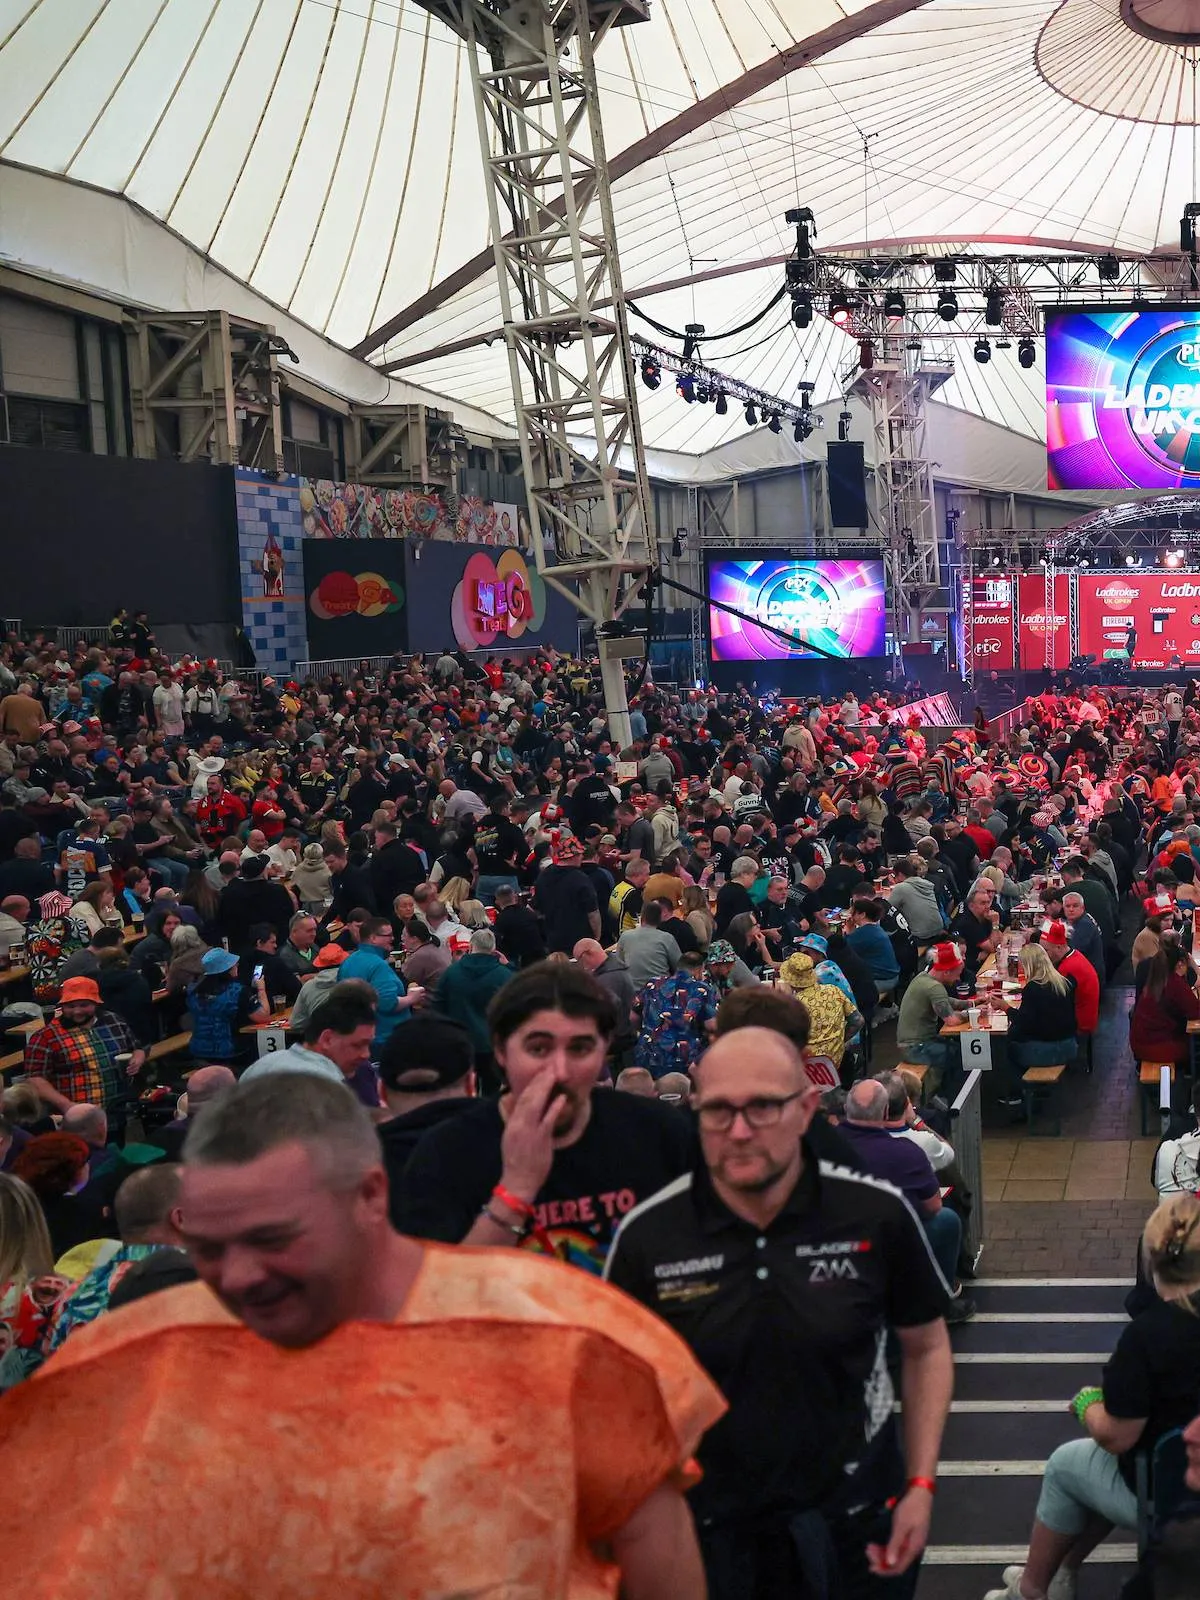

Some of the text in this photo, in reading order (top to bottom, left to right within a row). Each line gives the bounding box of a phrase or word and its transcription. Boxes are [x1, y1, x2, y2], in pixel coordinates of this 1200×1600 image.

[1132, 409, 1183, 434] UK
[1095, 587, 1140, 597] Ladbrokes
[761, 856, 788, 866] BOYS
[266, 1037, 277, 1052] 3
[970, 1039, 982, 1055] 6
[598, 1187, 636, 1217] TO
